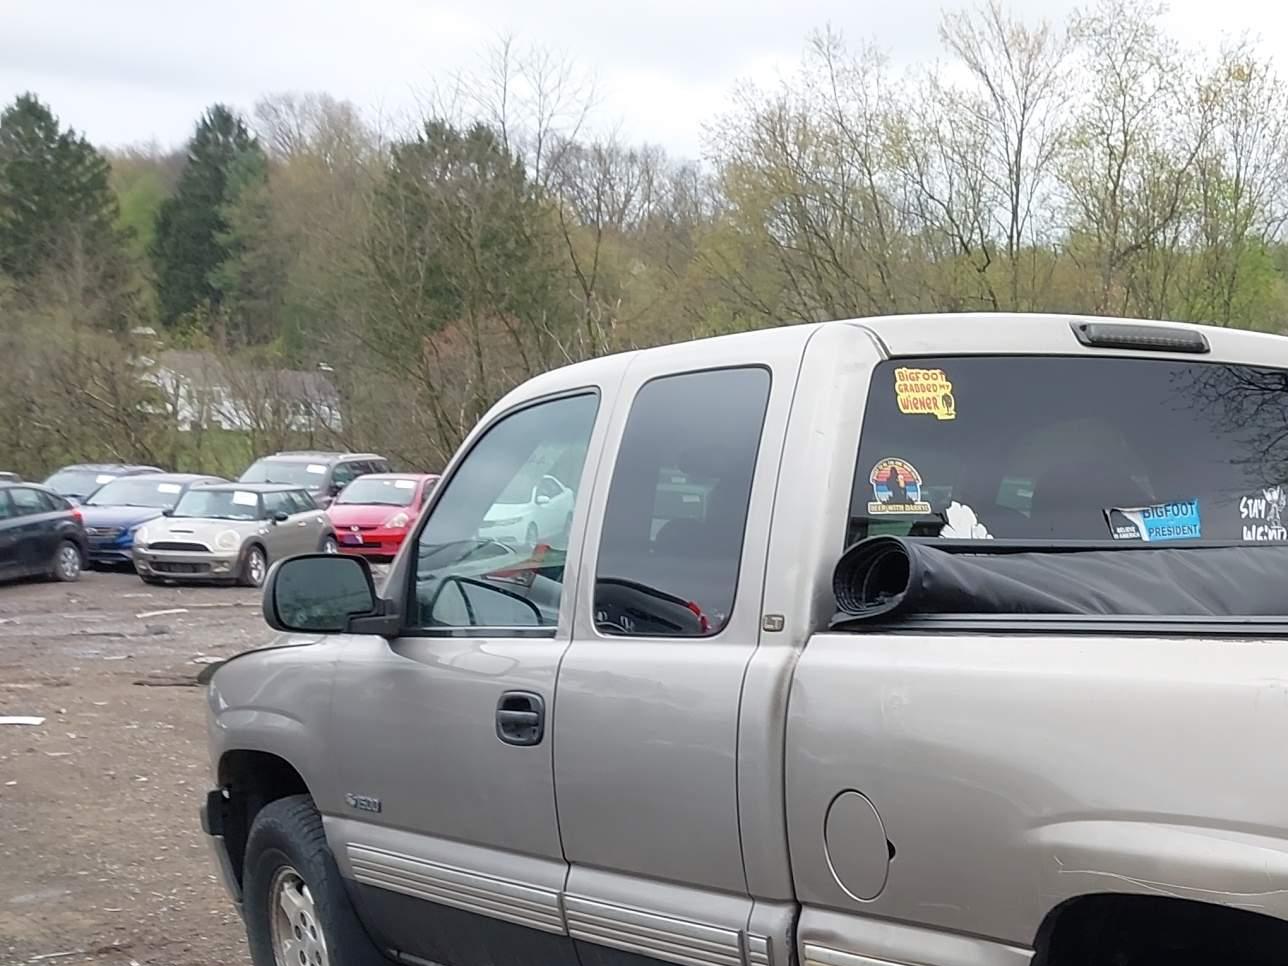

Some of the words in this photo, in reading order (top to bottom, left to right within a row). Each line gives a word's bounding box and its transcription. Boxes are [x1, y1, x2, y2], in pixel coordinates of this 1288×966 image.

[1143, 502, 1196, 519] BIGFOOT
[1240, 496, 1267, 519] STAY
[1148, 525, 1198, 537] PRESIDENT
